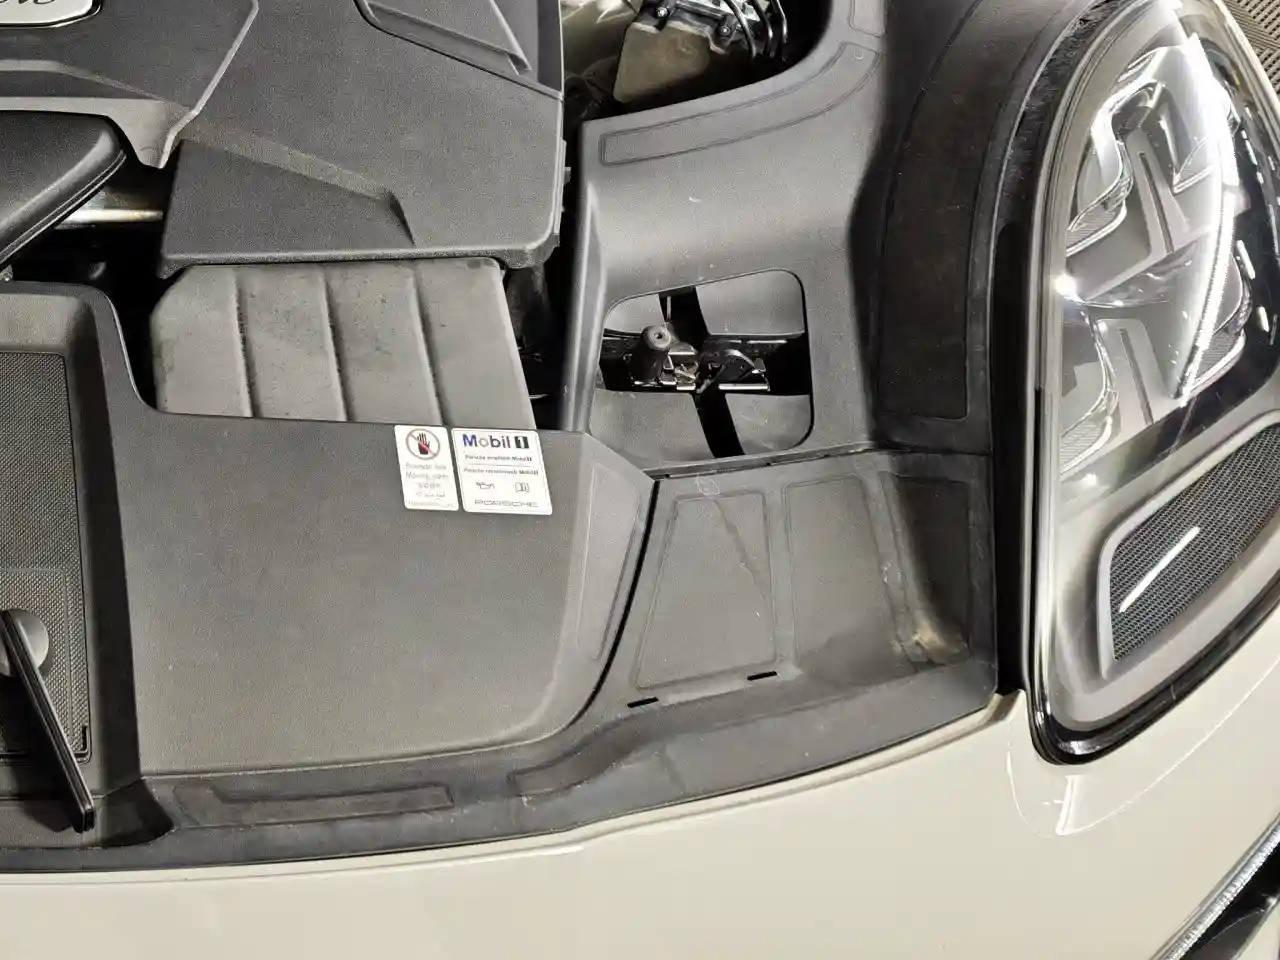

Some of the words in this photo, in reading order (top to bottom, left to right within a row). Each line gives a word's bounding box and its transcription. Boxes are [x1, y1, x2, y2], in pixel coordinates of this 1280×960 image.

[462, 433, 511, 449] Mobil
[514, 435, 530, 449] 1
[474, 499, 539, 508] PORSCHE
